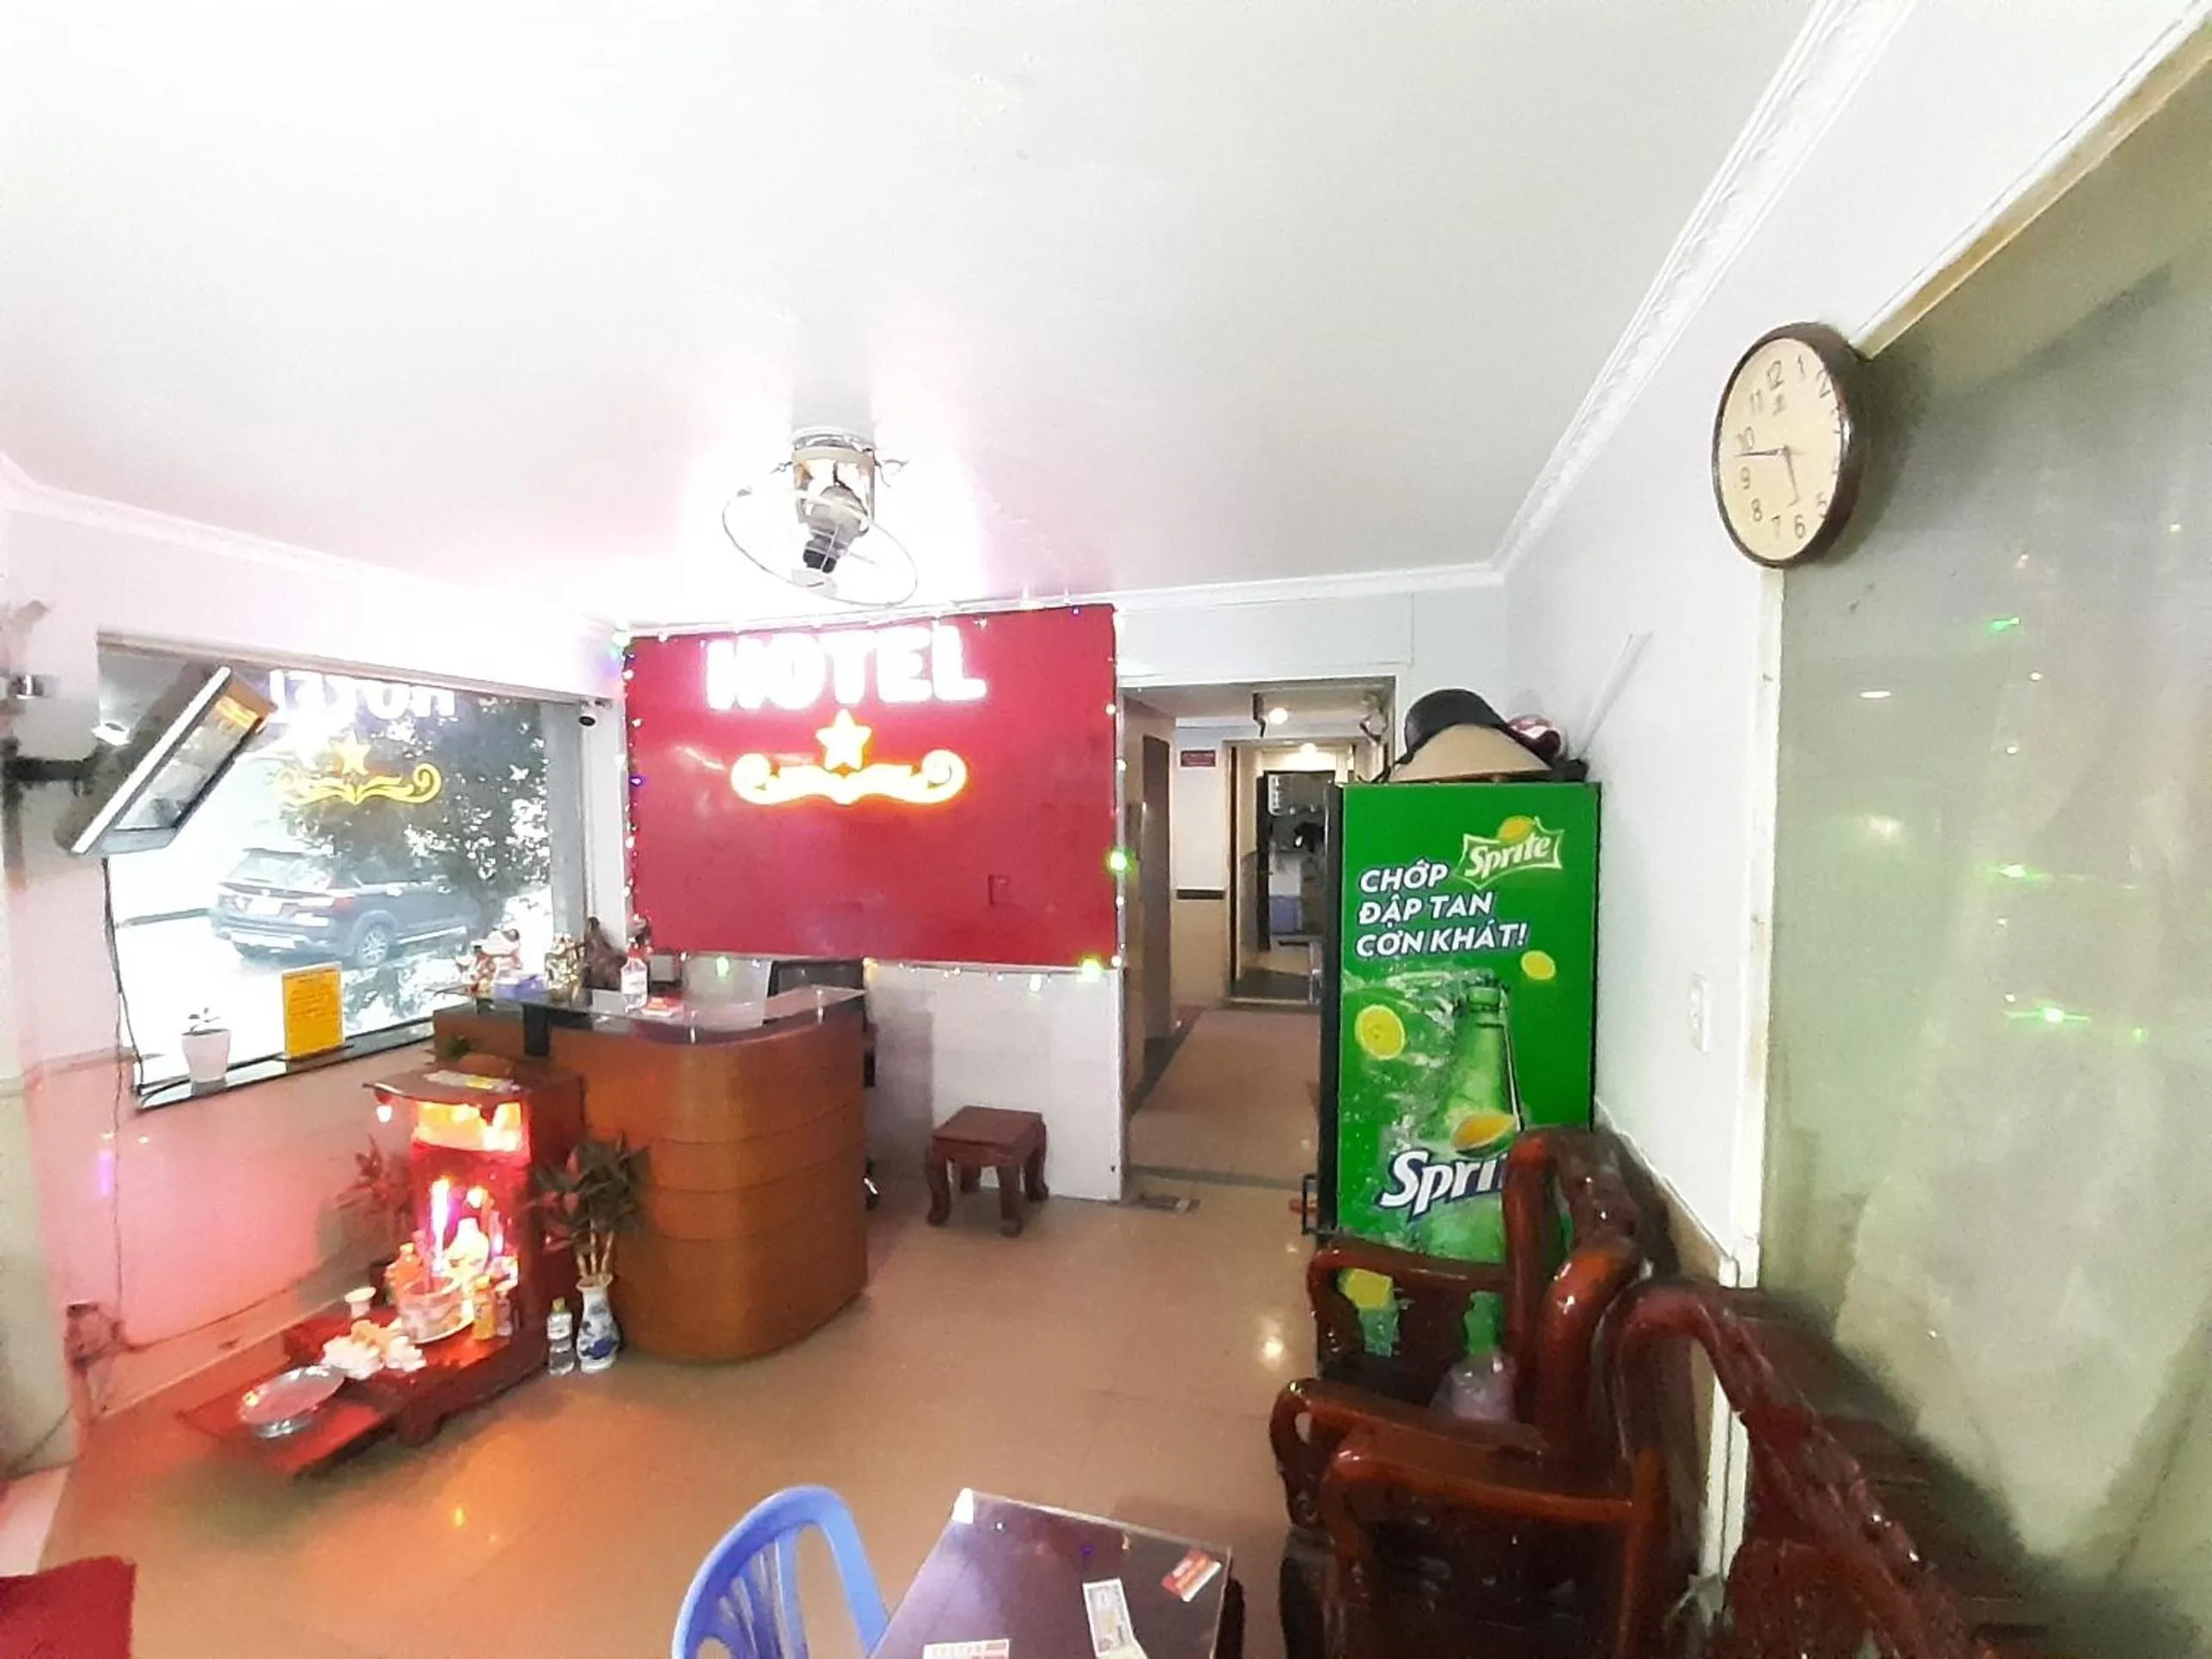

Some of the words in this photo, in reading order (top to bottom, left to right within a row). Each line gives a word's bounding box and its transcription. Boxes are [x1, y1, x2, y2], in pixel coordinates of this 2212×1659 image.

[1767, 360, 1784, 391] 12
[1750, 388, 1764, 416] 11
[1741, 466, 1750, 489] 9
[1751, 498, 1762, 522] 8
[1771, 515, 1781, 538] 7
[1795, 514, 1806, 539] 6
[1463, 831, 1552, 879] Sprite
[1359, 859, 1449, 893] CHỚP
[1358, 893, 1423, 928] ĐẬP
[1430, 891, 1493, 919] TAN
[1356, 930, 1425, 957] CƠN
[1429, 919, 1528, 953] KHÁT!
[1379, 1150, 1508, 1217] Spri
